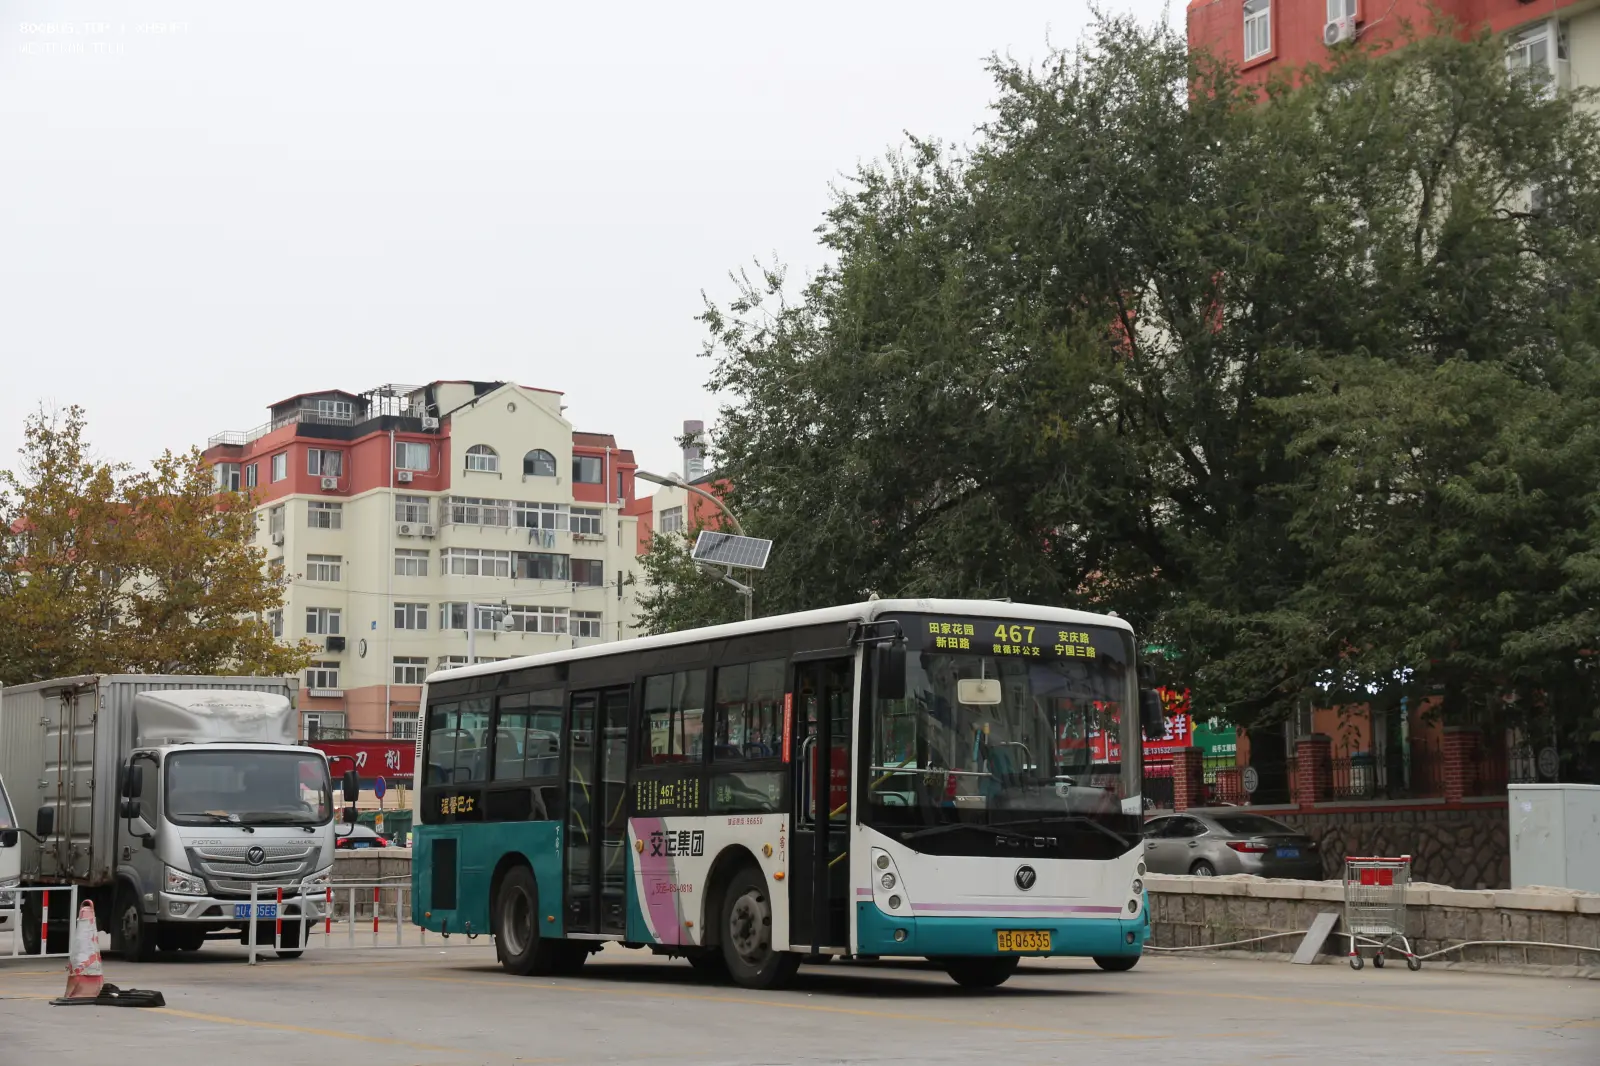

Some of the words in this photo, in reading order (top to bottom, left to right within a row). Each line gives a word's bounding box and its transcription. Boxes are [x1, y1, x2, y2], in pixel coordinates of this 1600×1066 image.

[929, 622, 974, 635] 田家花园
[994, 624, 1036, 643] 467
[936, 636, 970, 649] 新田路
[1058, 631, 1089, 643] 安庆路
[993, 644, 1040, 656] 微循环公交
[1054, 644, 1096, 658] 宁国三路
[660, 785, 674, 797] 467
[651, 830, 704, 857] 交运集团
